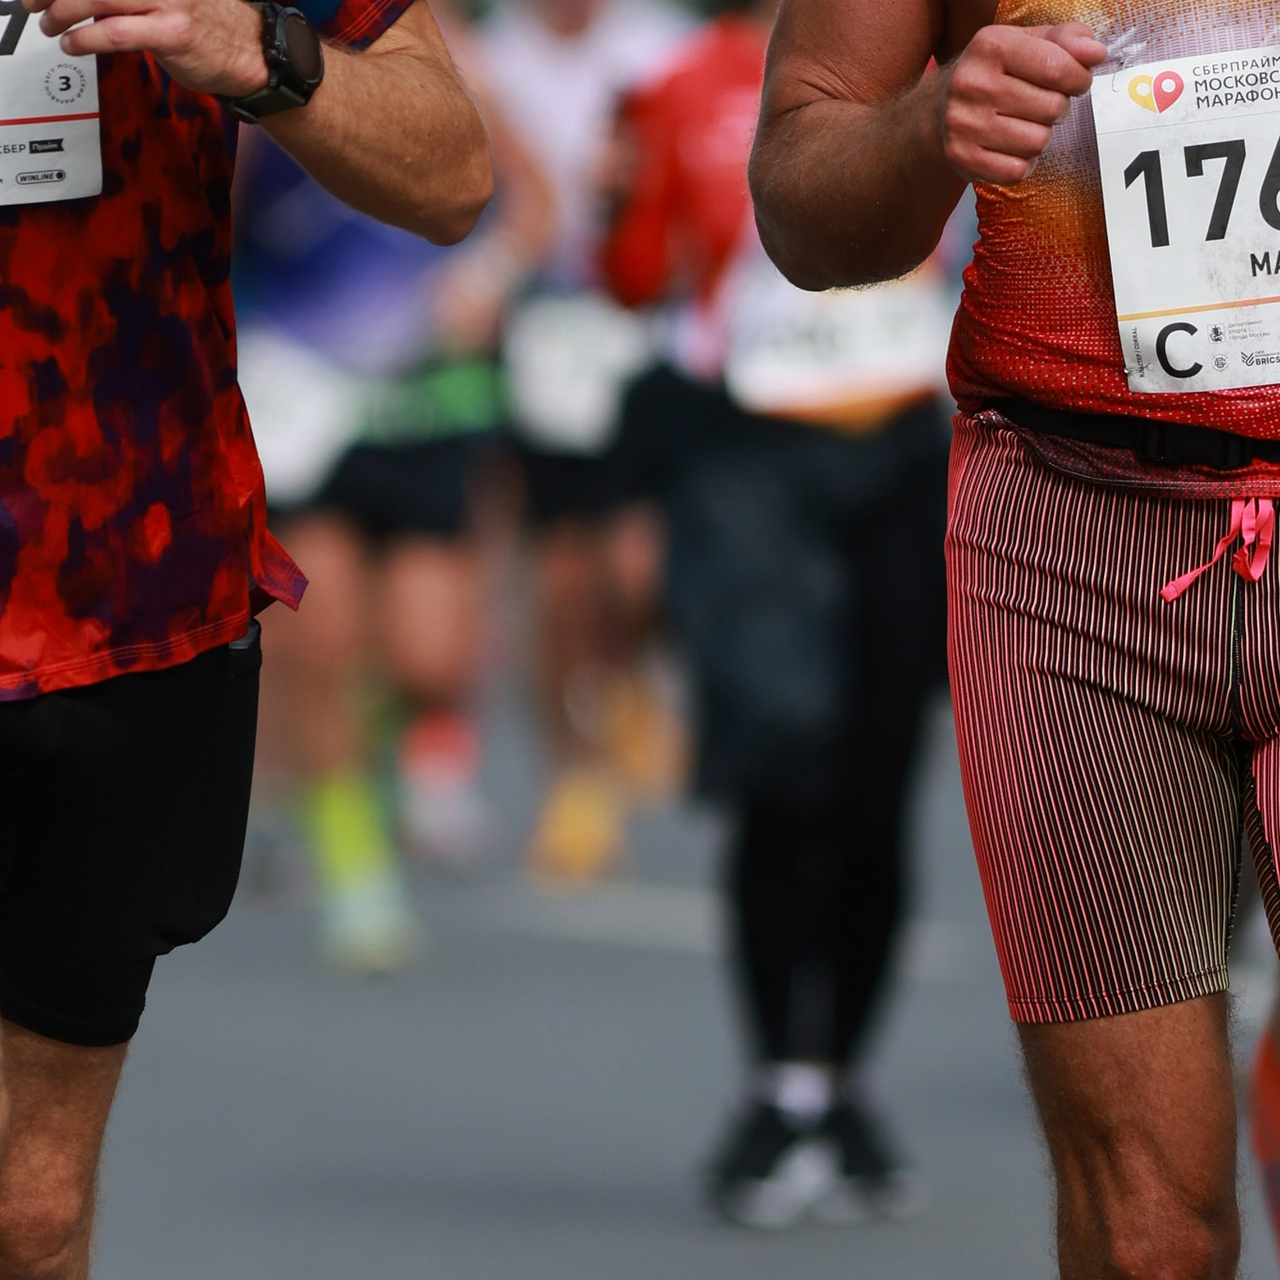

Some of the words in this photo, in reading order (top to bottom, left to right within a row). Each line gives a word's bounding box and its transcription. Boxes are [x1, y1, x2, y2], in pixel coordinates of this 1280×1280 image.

[58, 75, 72, 92] 3
[20, 173, 55, 182] WINLINE
[1155, 322, 1204, 379] C
[1255, 355, 1280, 366] BRICS
